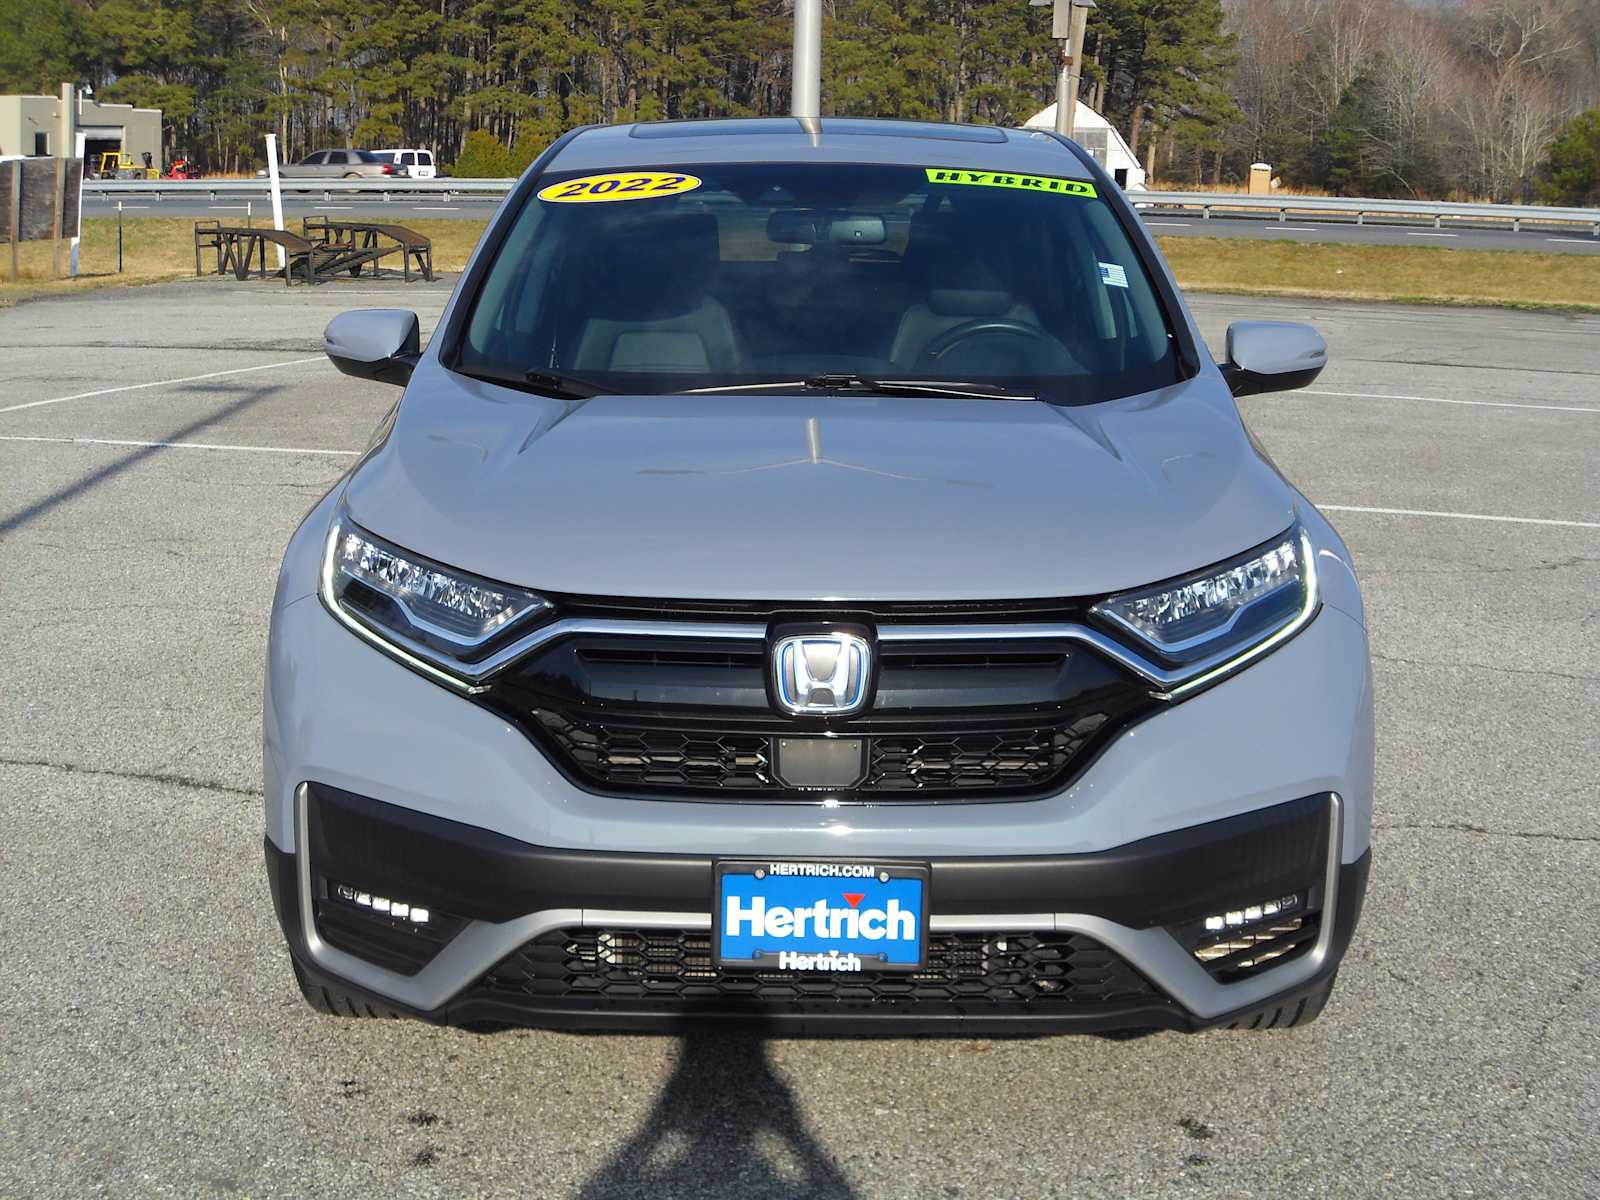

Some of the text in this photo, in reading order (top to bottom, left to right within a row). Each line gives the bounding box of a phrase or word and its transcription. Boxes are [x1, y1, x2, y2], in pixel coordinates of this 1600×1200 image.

[554, 177, 686, 198] 2022
[935, 172, 1090, 193] HYBRID
[769, 864, 875, 878] HERTRICH.COM
[726, 894, 916, 940] Hertrich
[779, 950, 861, 971] Hertrich
